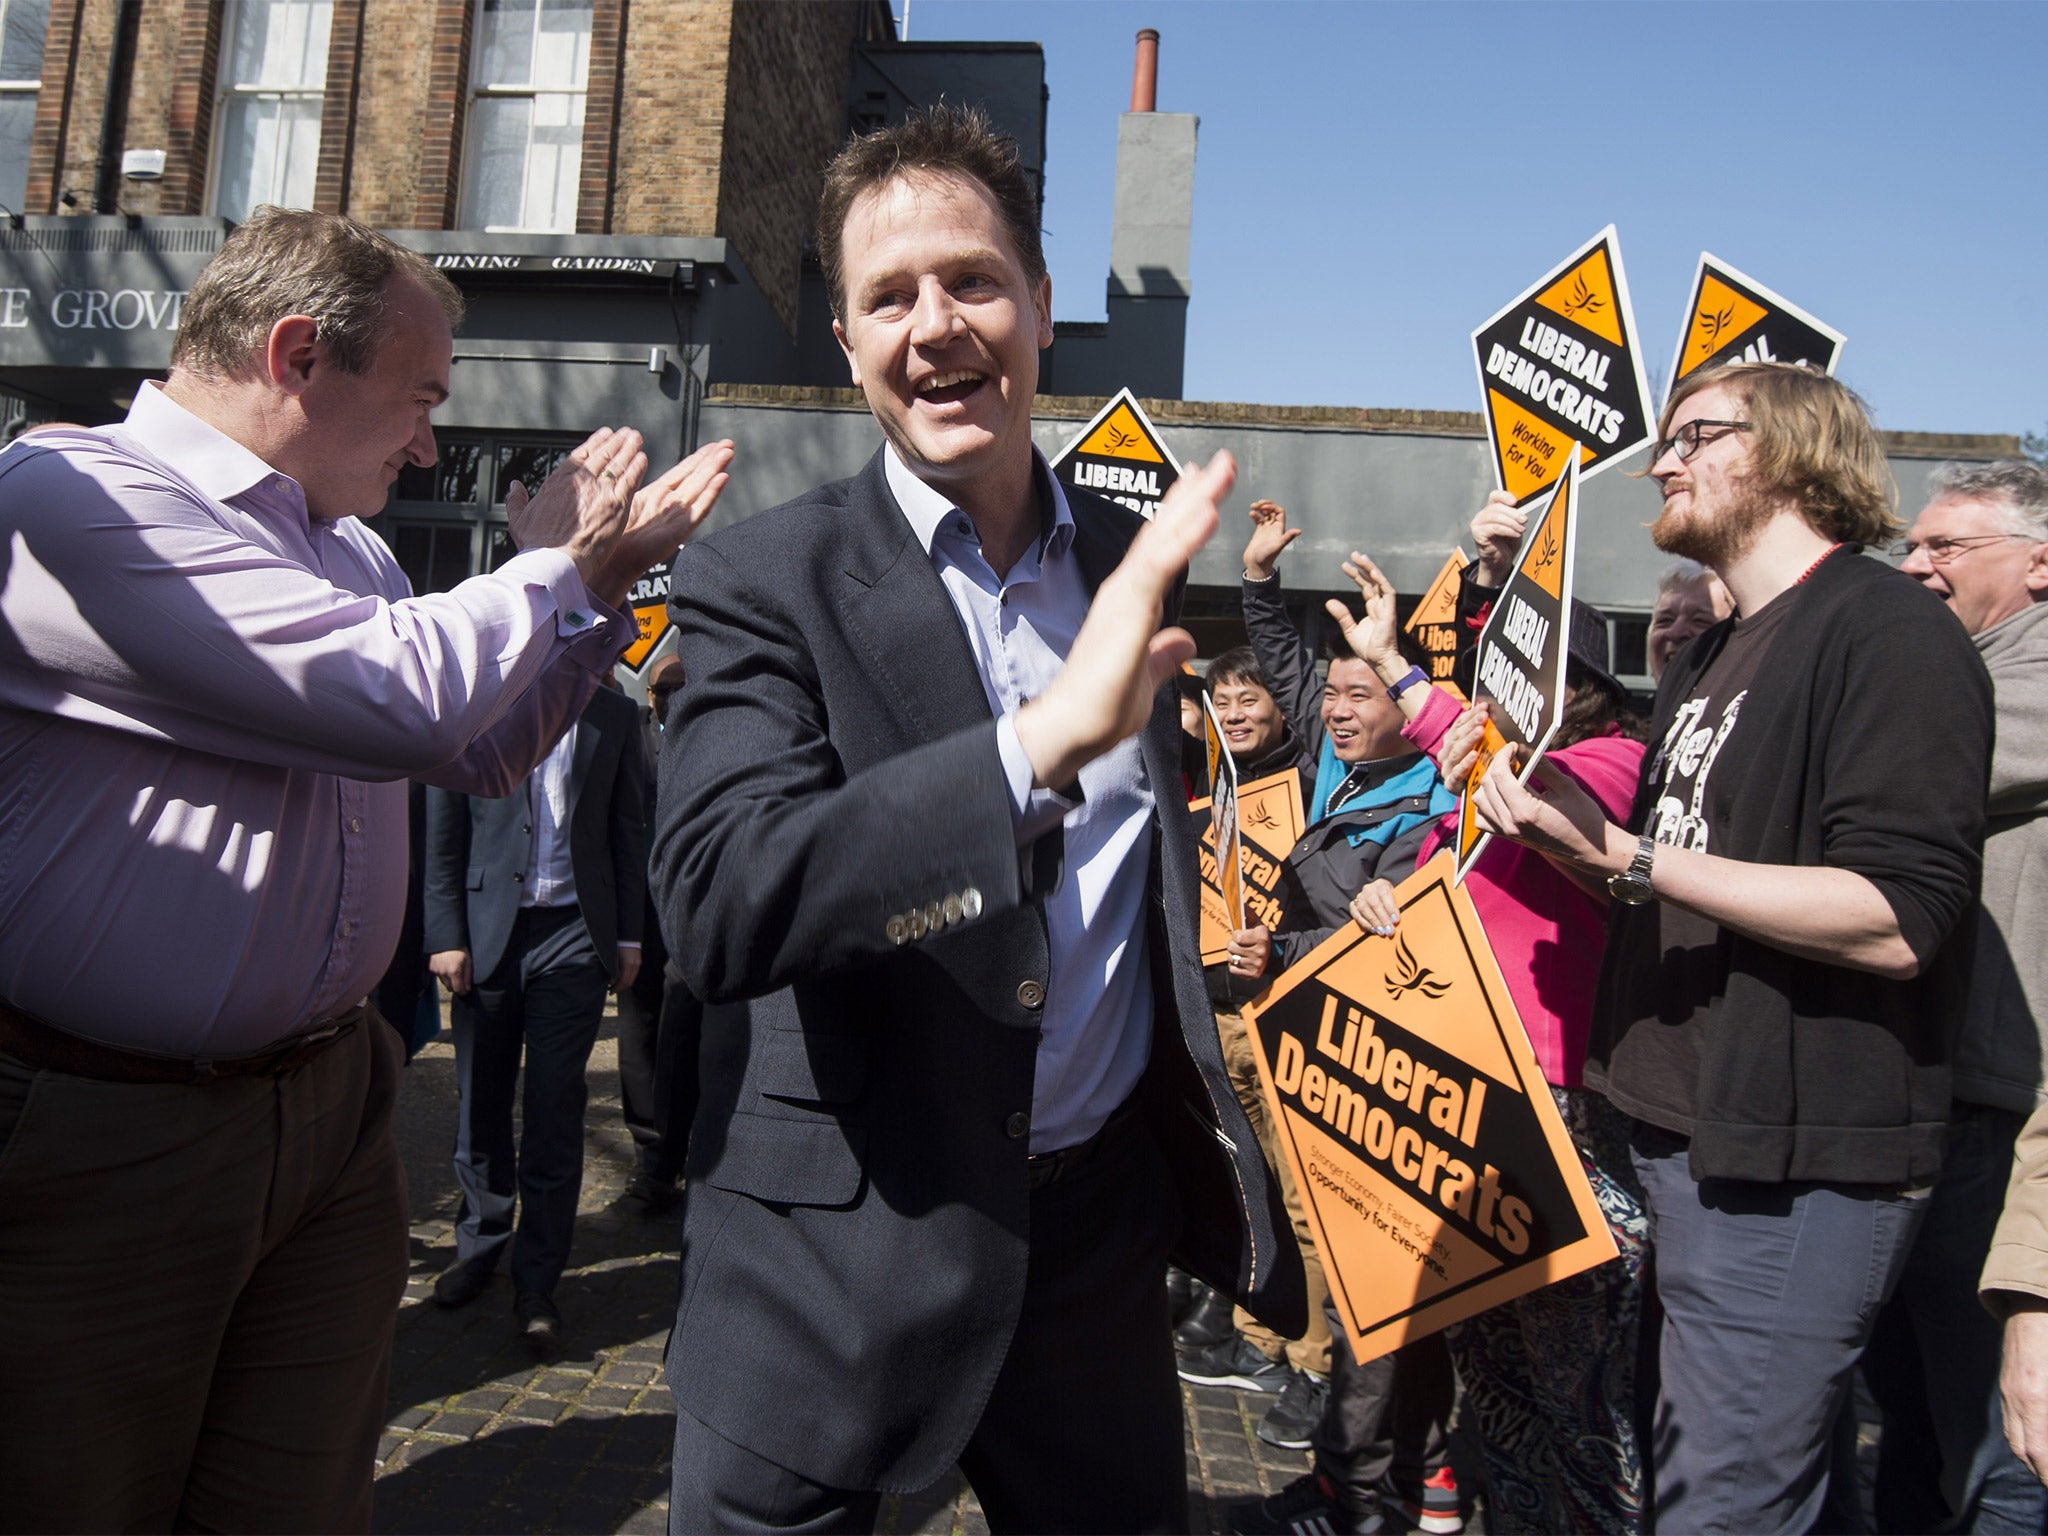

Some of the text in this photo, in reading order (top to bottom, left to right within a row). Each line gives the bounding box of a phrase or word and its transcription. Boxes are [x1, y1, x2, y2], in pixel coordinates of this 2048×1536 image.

[434, 254, 657, 274] DINING GARDEN
[0, 287, 32, 328] E
[1519, 316, 1611, 392] LIBERAL
[1485, 342, 1625, 445] DEMOCRATS
[1073, 461, 1162, 496] LIBERAL
[1505, 445, 1547, 480] For You
[1511, 420, 1556, 461] Working
[1502, 594, 1551, 670] LIBERAL
[1479, 640, 1544, 744] DEMOCRATS
[1315, 992, 1489, 1149] Liberal
[1274, 1030, 1535, 1257] Democrats
[1309, 1162, 1449, 1281] Opportunity for Everyone.
[1311, 1145, 1344, 1177] Stronger
[1387, 1203, 1412, 1229] Fairer
